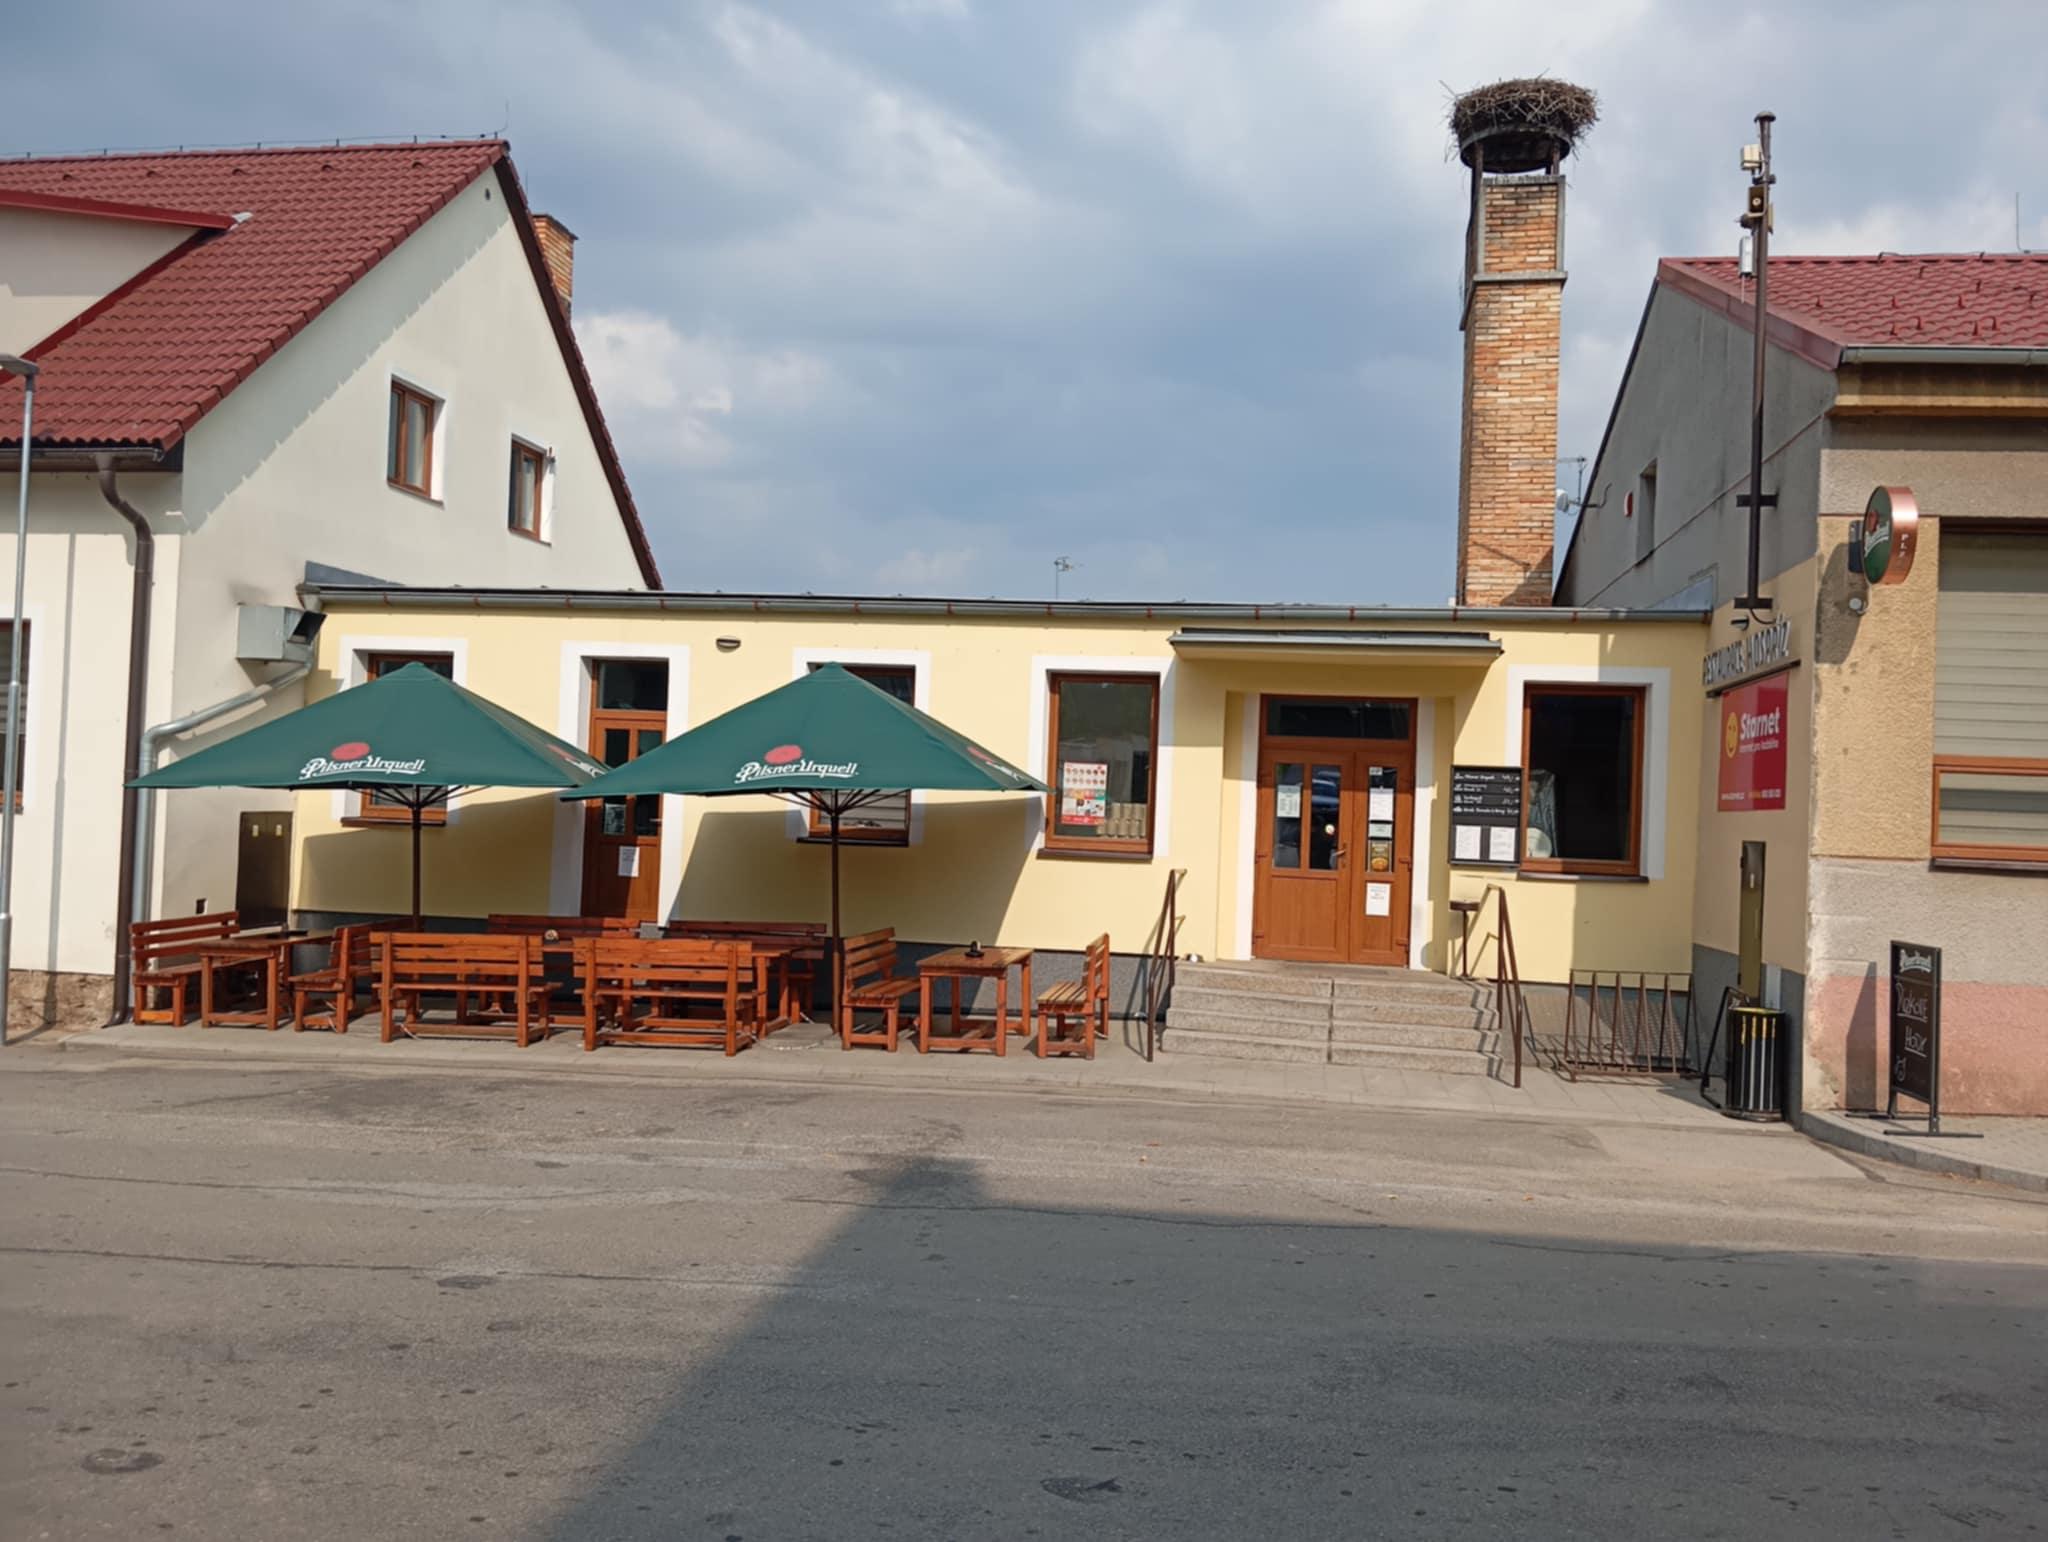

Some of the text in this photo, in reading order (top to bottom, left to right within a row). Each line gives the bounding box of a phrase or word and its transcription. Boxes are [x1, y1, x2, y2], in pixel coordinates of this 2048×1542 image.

[1740, 706, 1780, 740] Starnet
[298, 755, 426, 780] Pilsner Urquell
[733, 759, 859, 784] Pilsner Urquell
